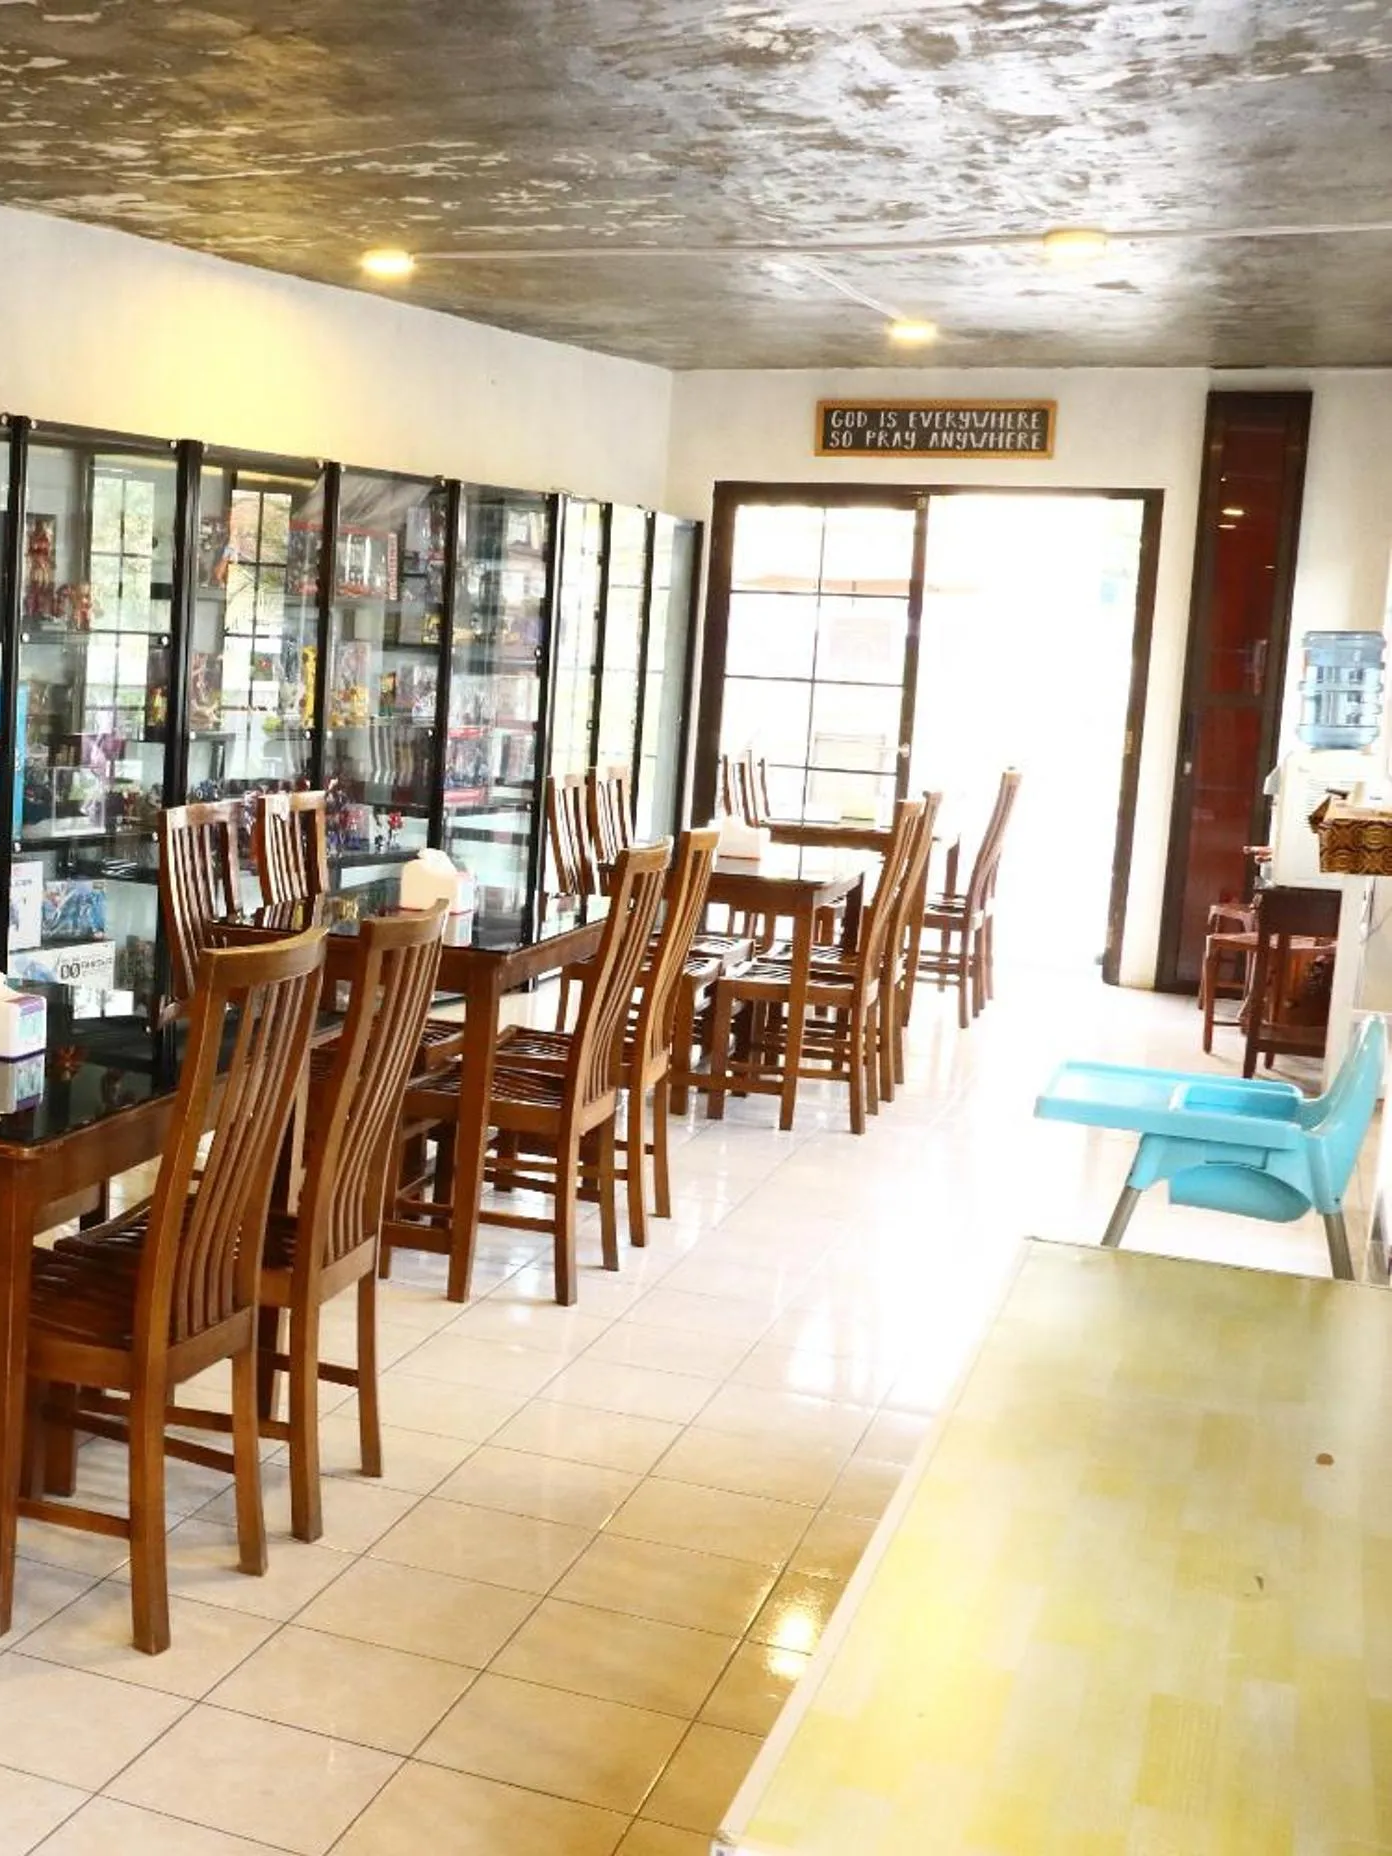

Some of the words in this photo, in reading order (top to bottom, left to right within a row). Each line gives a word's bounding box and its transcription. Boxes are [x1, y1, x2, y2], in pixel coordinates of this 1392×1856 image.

[830, 410, 868, 428] GOD
[879, 410, 898, 428] IS
[908, 411, 1042, 430] EVERYWHERE
[829, 430, 853, 448] SO
[865, 431, 917, 449] PRAY
[928, 431, 1042, 450] ANYWHERE
